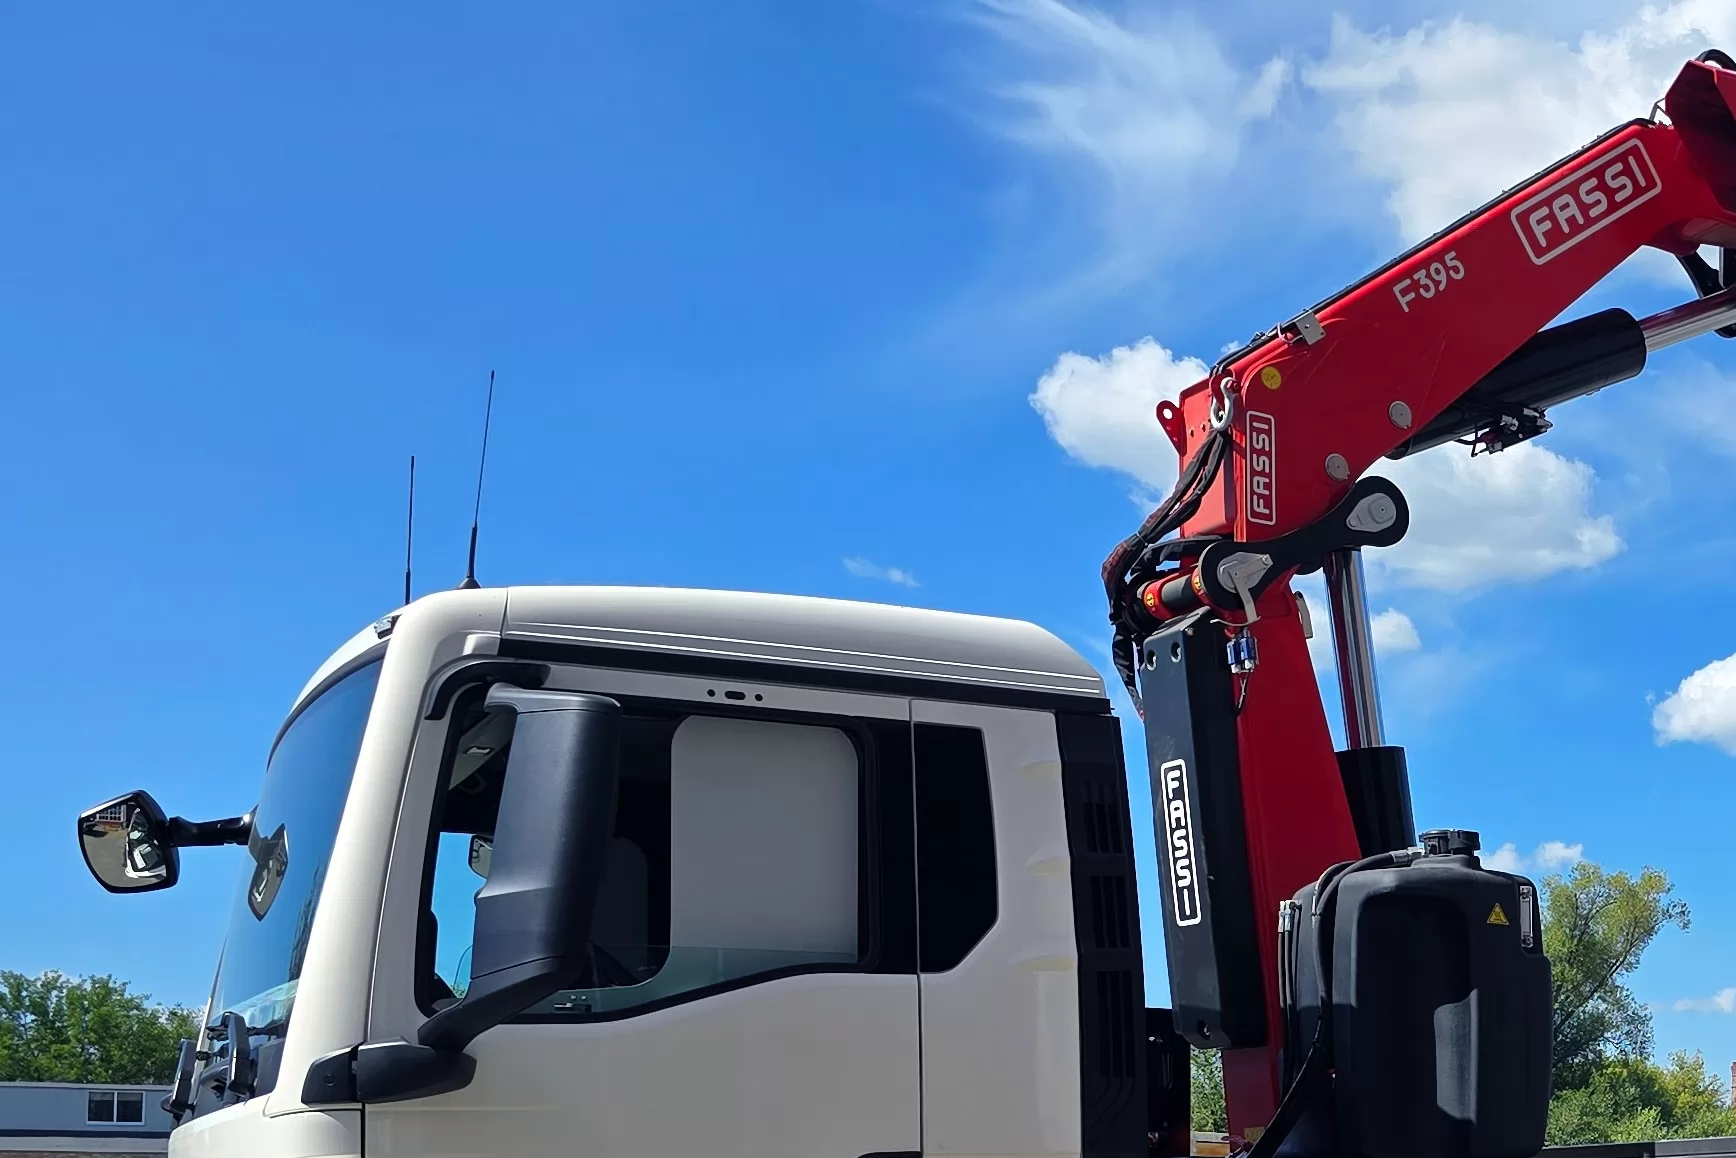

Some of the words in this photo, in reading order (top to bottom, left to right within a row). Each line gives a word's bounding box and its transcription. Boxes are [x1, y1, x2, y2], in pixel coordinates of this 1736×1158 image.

[1528, 155, 1647, 248] FASSI
[1392, 250, 1465, 313] F395
[1252, 421, 1270, 514] FASSI
[1166, 769, 1192, 916] FASSI
